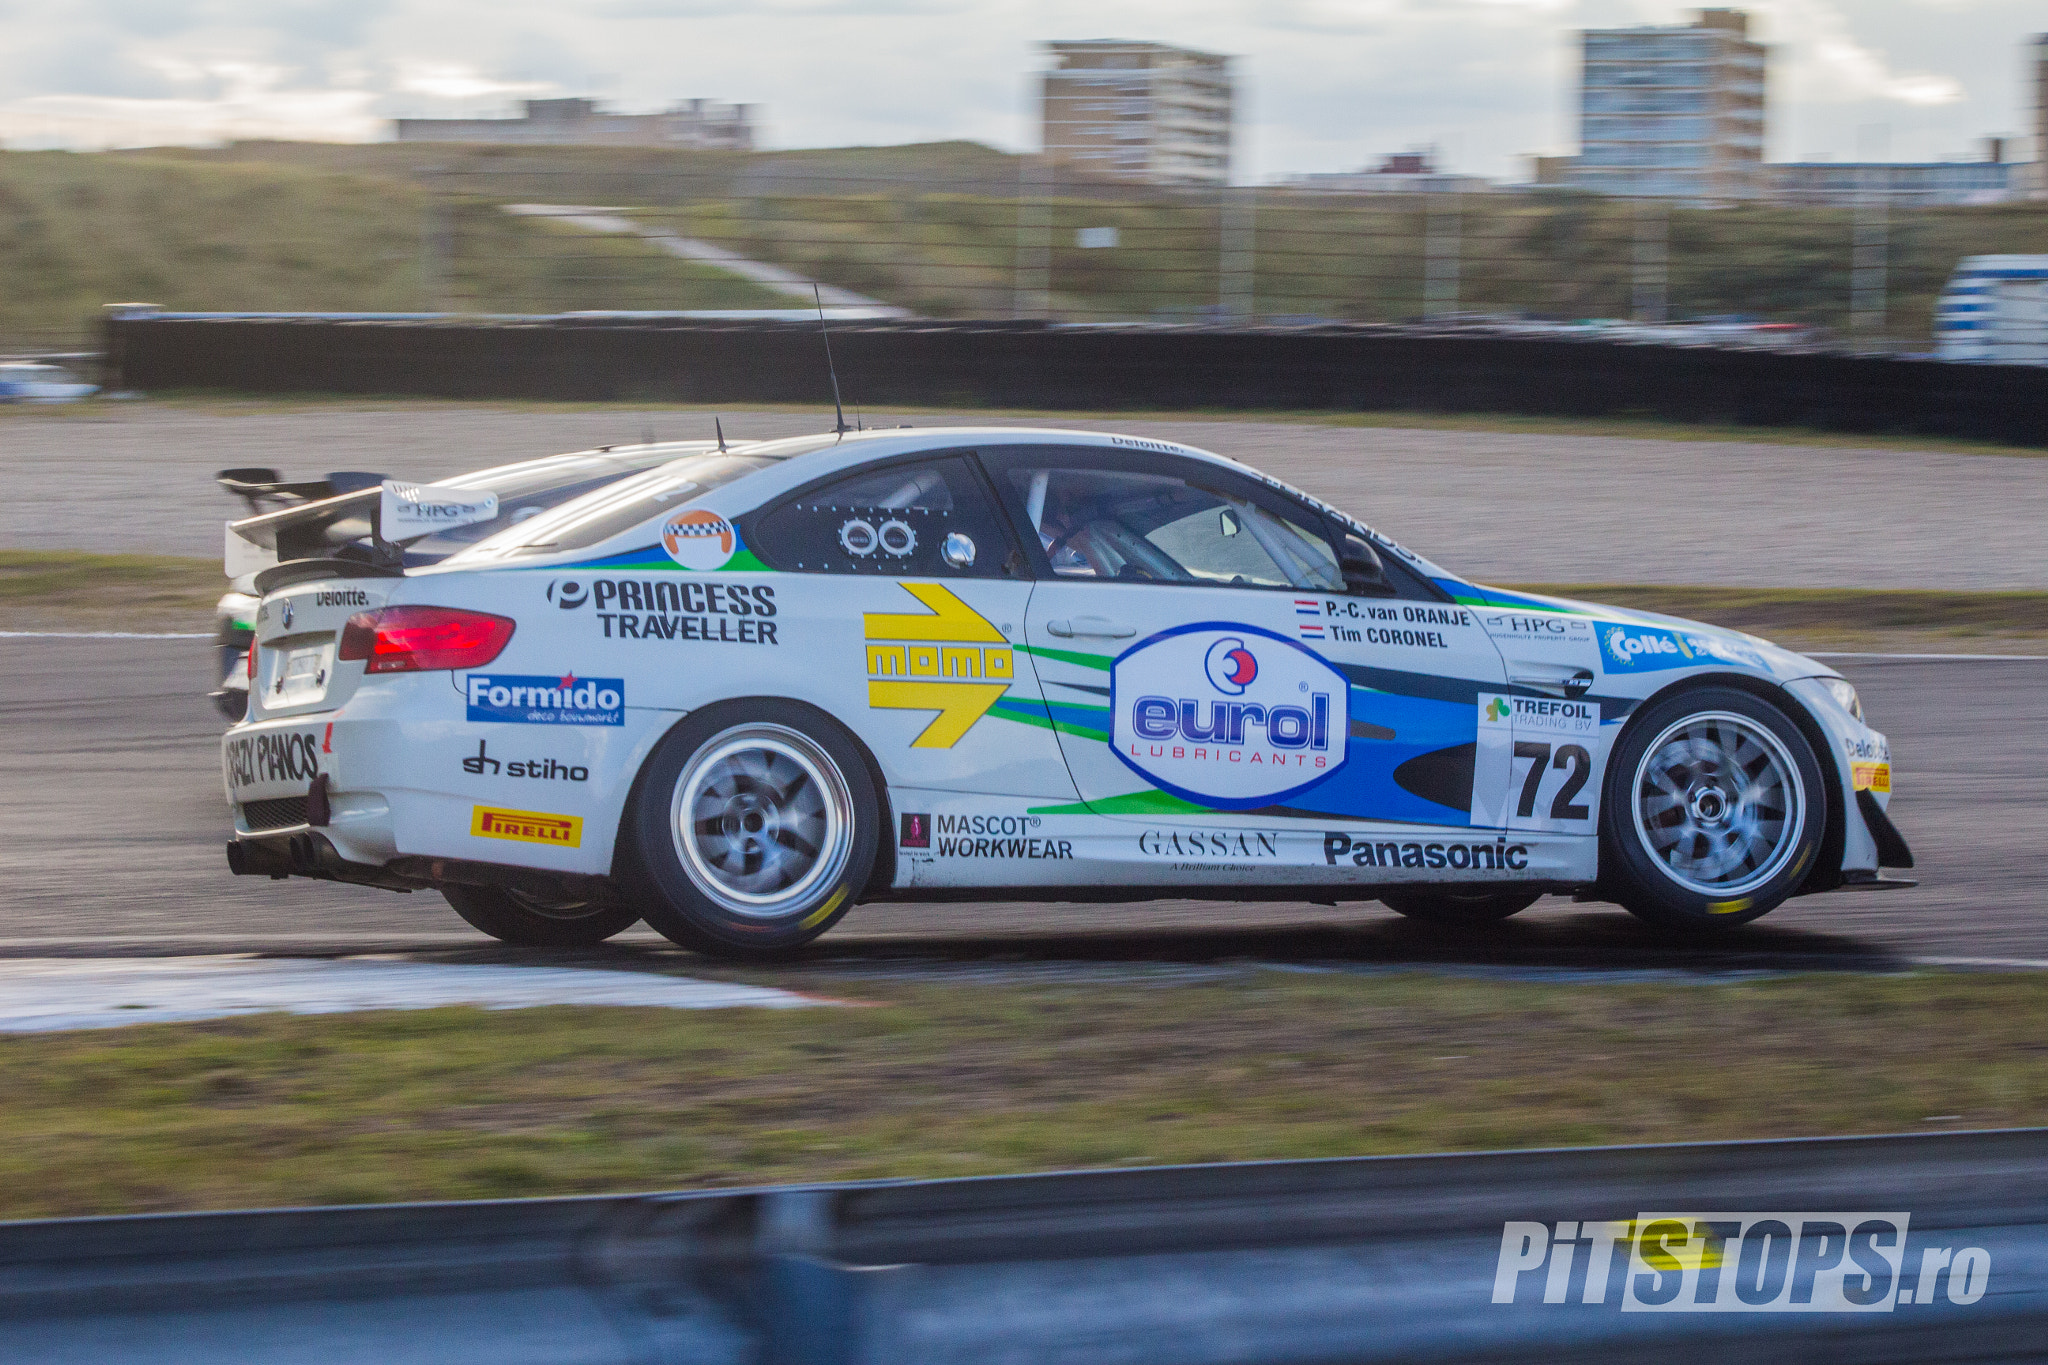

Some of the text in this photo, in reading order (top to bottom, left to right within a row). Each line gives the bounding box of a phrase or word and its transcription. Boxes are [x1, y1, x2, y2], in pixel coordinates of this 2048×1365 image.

[593, 579, 778, 617] PRINCESS
[597, 612, 779, 646] TRAVELLER
[1367, 607, 1398, 621] van
[1402, 606, 1471, 626] ORANJE
[1511, 617, 1565, 634] HPG
[1330, 625, 1448, 649] Tim CORONEL
[1609, 629, 1680, 662] Collé
[468, 677, 621, 711] Formido
[1132, 692, 1330, 752] eurol
[1513, 698, 1592, 720] TREFOIL
[1513, 716, 1592, 731] TRADING BV
[507, 758, 589, 782] stiho
[1131, 744, 1327, 769] LUBRICANTS
[1513, 740, 1592, 820] 72
[481, 812, 573, 842] PIRELLI
[938, 837, 1074, 860] WORKWEAR
[1138, 829, 1278, 858] GASSAN
[1323, 831, 1529, 871] Panasonic
[1170, 863, 1179, 871] A
[1222, 864, 1257, 873] Choice
